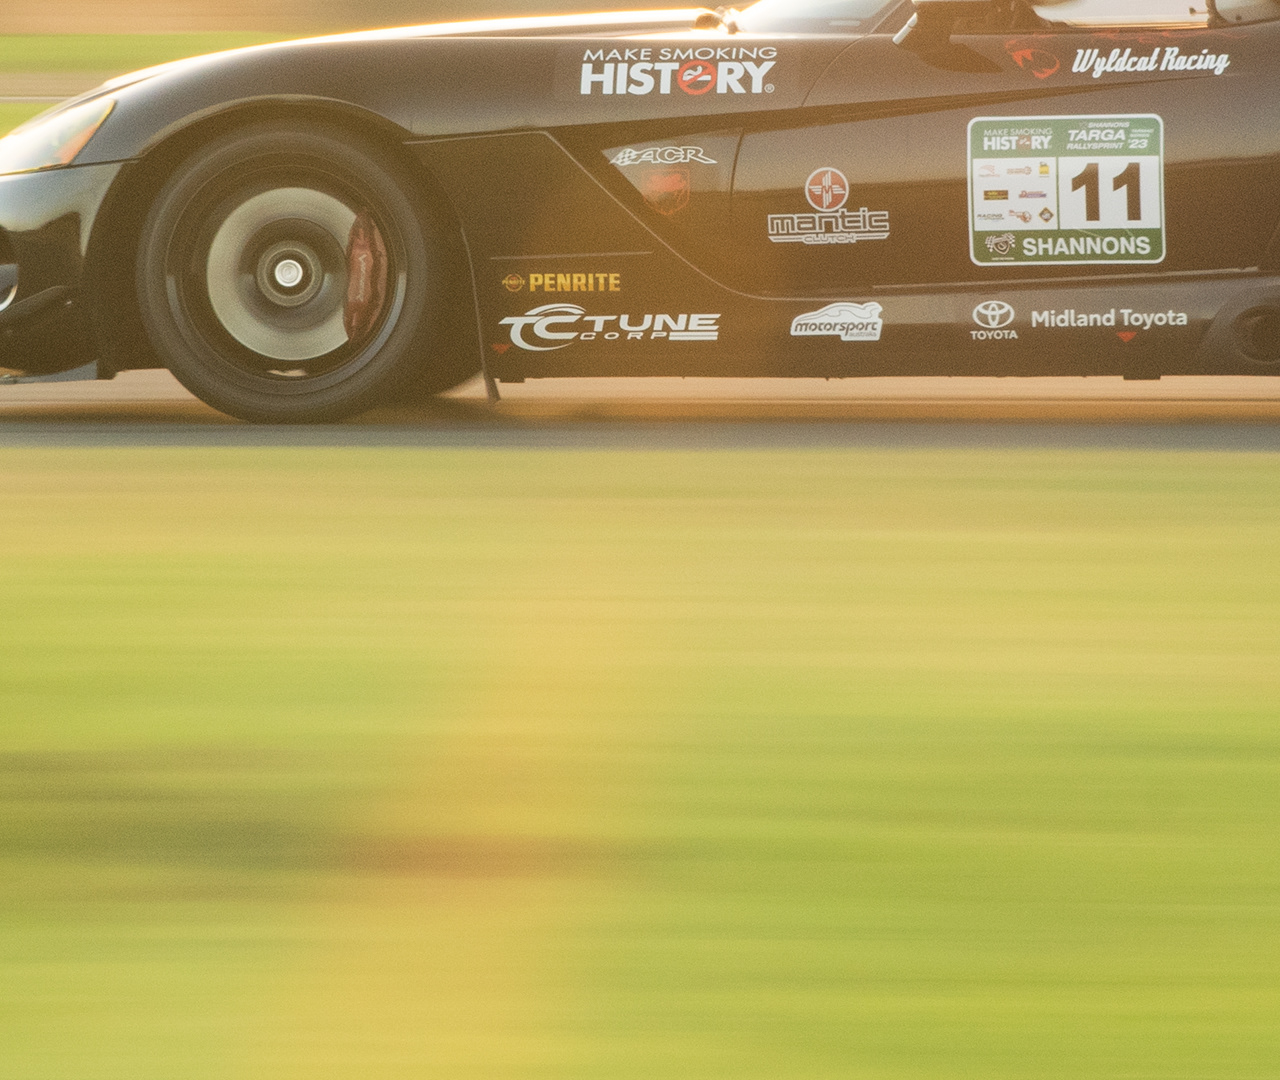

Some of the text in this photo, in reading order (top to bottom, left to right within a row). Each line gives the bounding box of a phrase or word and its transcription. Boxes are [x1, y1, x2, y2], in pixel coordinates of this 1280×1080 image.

[583, 47, 777, 61] MAKE SMOKING
[1072, 47, 1230, 78] Wyldcat Racing
[983, 127, 1053, 136] MAKE SMOKING
[1067, 129, 1126, 141] TARGA
[1066, 142, 1124, 150] RALLYSPRINT
[634, 146, 718, 164] ACR
[1071, 162, 1142, 221] 11
[768, 207, 890, 234] mantic
[803, 234, 856, 243] CLUTCH
[1022, 236, 1151, 257] SHANNONS
[529, 273, 621, 292] PENRITE
[583, 314, 721, 333] TUNE
[1031, 308, 1188, 330] Midland Toyota
[579, 332, 668, 341] CORP
[794, 320, 878, 336] motorsport
[970, 330, 1018, 340] TOYOTA
